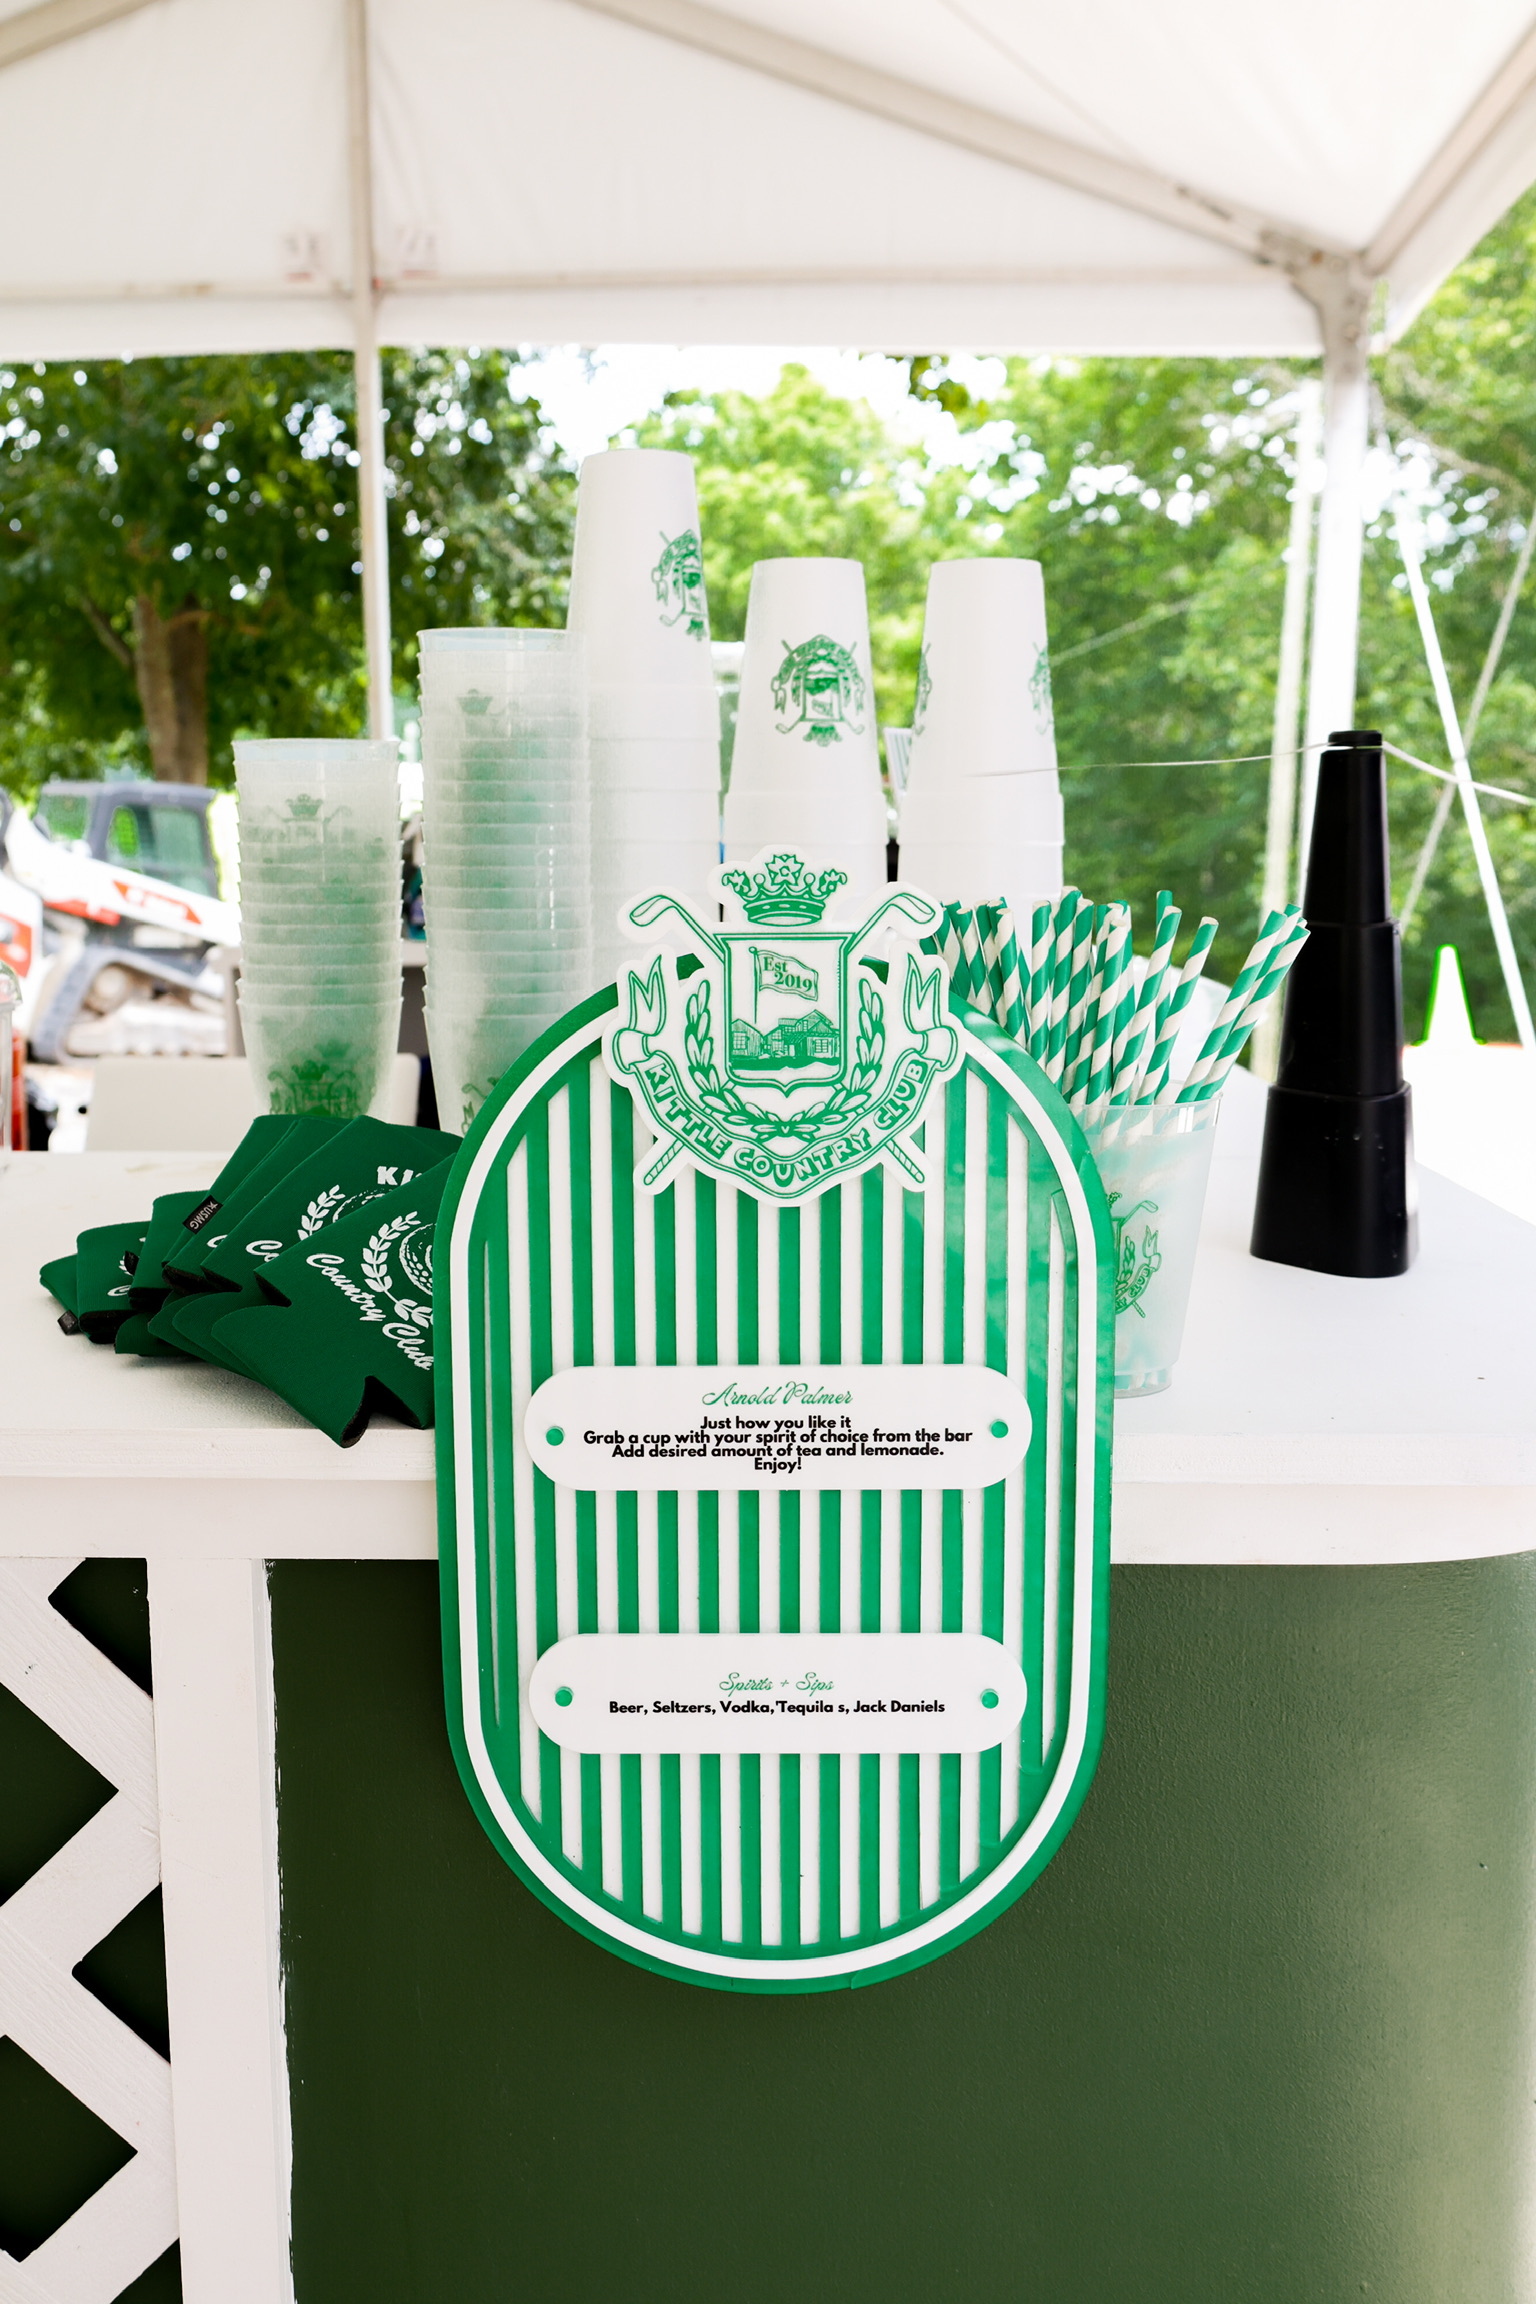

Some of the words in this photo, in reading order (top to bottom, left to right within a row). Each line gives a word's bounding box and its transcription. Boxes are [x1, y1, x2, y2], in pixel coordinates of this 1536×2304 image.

[763, 956, 788, 972] Est
[774, 971, 813, 992] 2019
[645, 1062, 733, 1160] KITTLE
[733, 1128, 872, 1188] COUNTRY
[873, 1059, 929, 1131] CLUB
[306, 1253, 387, 1322] Country
[382, 1322, 434, 1371] Club
[702, 1382, 782, 1407] Arnold
[783, 1381, 853, 1405] Palmer
[700, 1416, 731, 1429] Just
[735, 1416, 771, 1429] how
[774, 1419, 804, 1432] you
[808, 1415, 837, 1428] like
[840, 1415, 852, 1428] it
[583, 1430, 625, 1444] Grab
[628, 1434, 639, 1444] a
[642, 1434, 671, 1447] cup
[674, 1430, 711, 1444] with
[714, 1433, 751, 1447] your
[755, 1429, 797, 1446] spirit
[800, 1429, 817, 1443] of
[819, 1429, 869, 1443] choice
[872, 1428, 911, 1442] from
[915, 1428, 941, 1442] the
[944, 1428, 973, 1442] bar
[611, 1444, 645, 1458] Add
[648, 1444, 708, 1458] desired
[711, 1445, 773, 1457] amount
[776, 1443, 793, 1457] of
[797, 1444, 822, 1456] tea
[825, 1442, 857, 1456] and
[860, 1442, 945, 1456] lemonade.
[754, 1456, 802, 1474] Enjoy!
[718, 1671, 774, 1698] Spirits
[795, 1671, 835, 1697] Sips
[609, 1700, 649, 1715] Beer,
[652, 1700, 716, 1715] Seltzers,
[719, 1700, 775, 1715] Vodka,
[853, 1700, 888, 1713] Jack
[890, 1699, 946, 1713] Daniels
